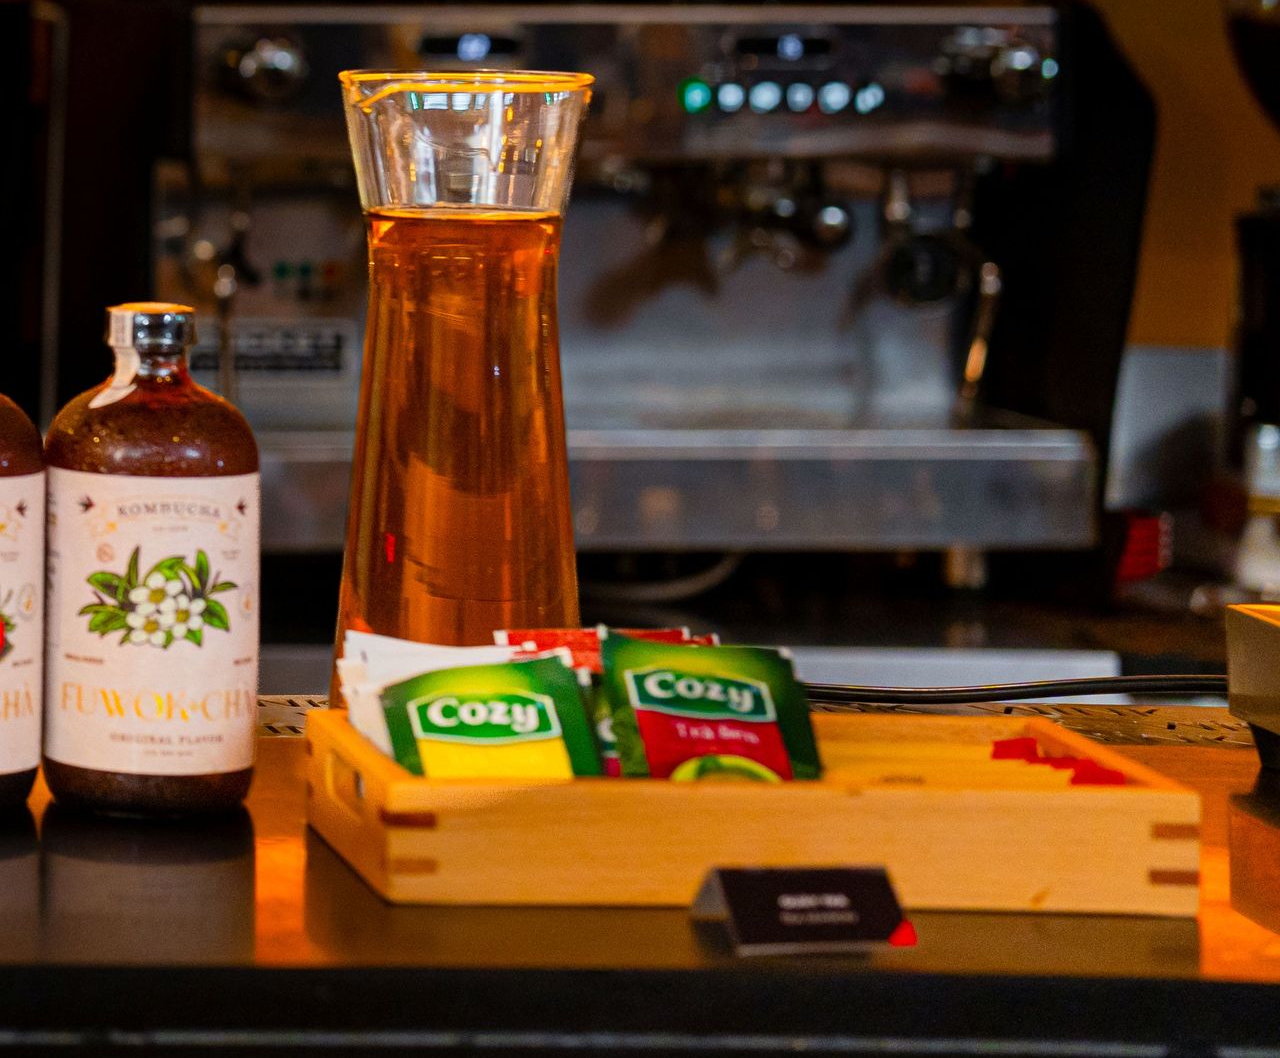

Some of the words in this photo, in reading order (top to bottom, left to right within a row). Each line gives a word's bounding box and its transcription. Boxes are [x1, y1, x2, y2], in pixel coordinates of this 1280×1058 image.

[116, 501, 221, 519] KOMBUCHA
[643, 671, 755, 714] Cozy
[426, 695, 540, 734] Cozy
[108, 733, 173, 745] ORIGINAL
